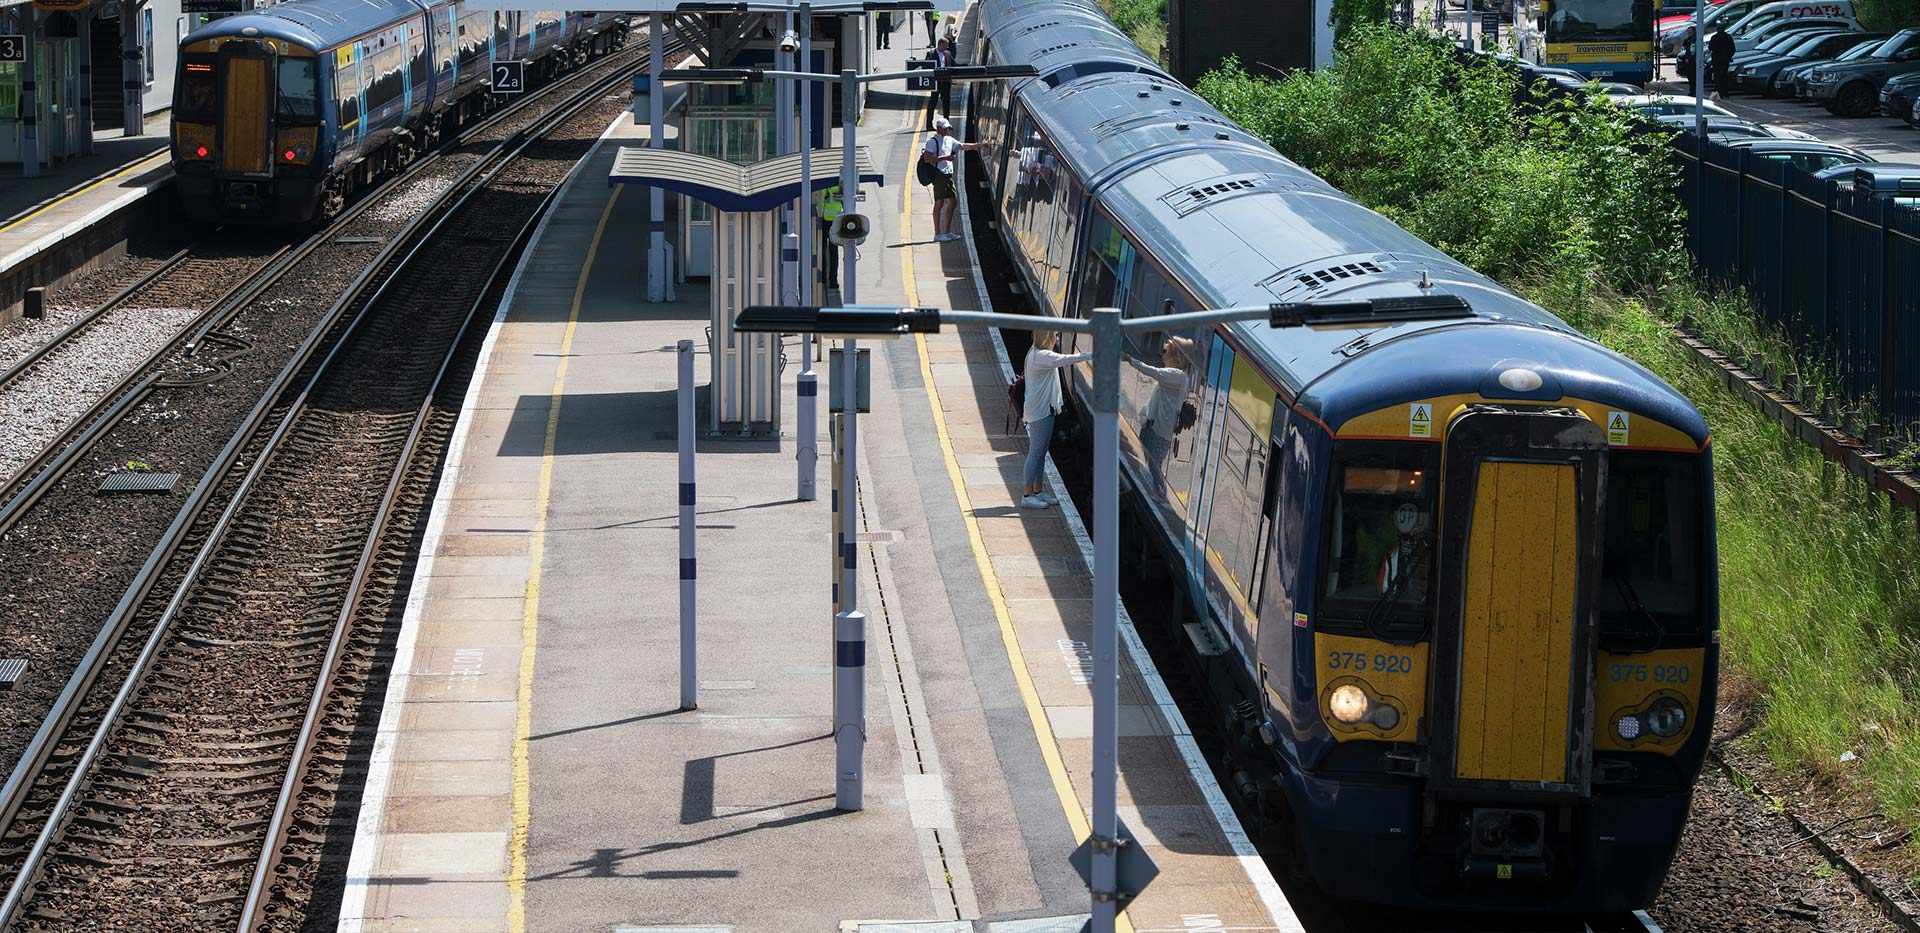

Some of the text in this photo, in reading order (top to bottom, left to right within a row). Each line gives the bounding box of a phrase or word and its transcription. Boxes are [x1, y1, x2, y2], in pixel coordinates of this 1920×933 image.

[2, 39, 22, 58] 3a
[496, 66, 519, 88] 2a
[1328, 651, 1413, 674] 375 920
[1609, 663, 1690, 684] 375 920
